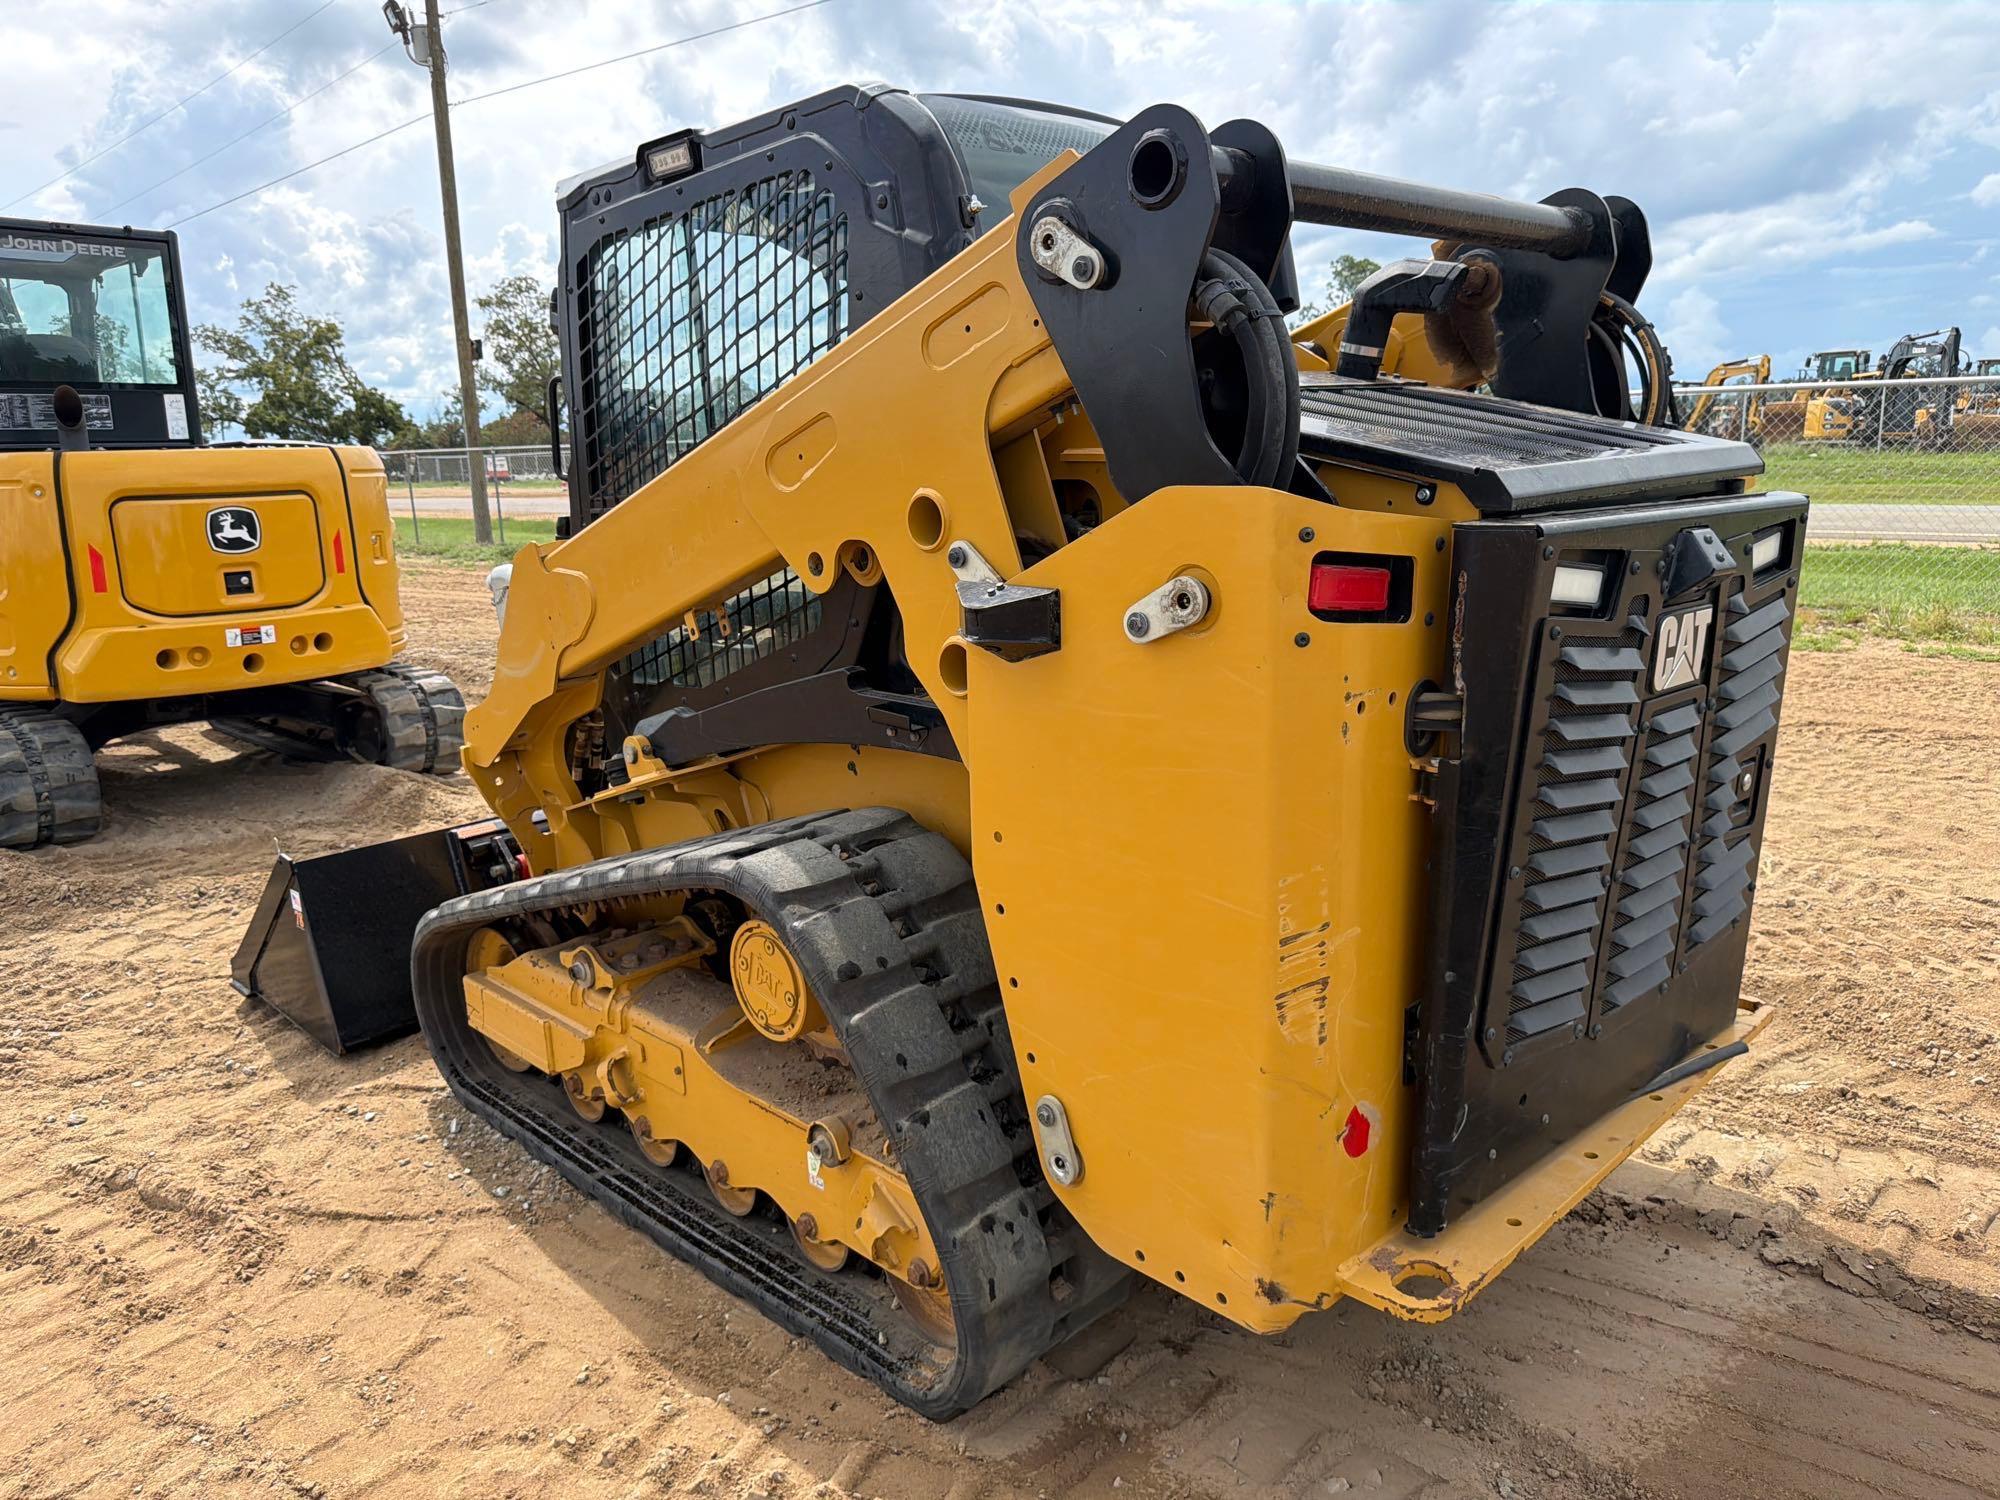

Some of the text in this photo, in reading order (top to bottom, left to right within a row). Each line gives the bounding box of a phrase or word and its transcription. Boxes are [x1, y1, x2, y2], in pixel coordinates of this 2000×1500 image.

[3, 235, 126, 258] JOHN DEERE
[1653, 608, 1713, 691] CAT
